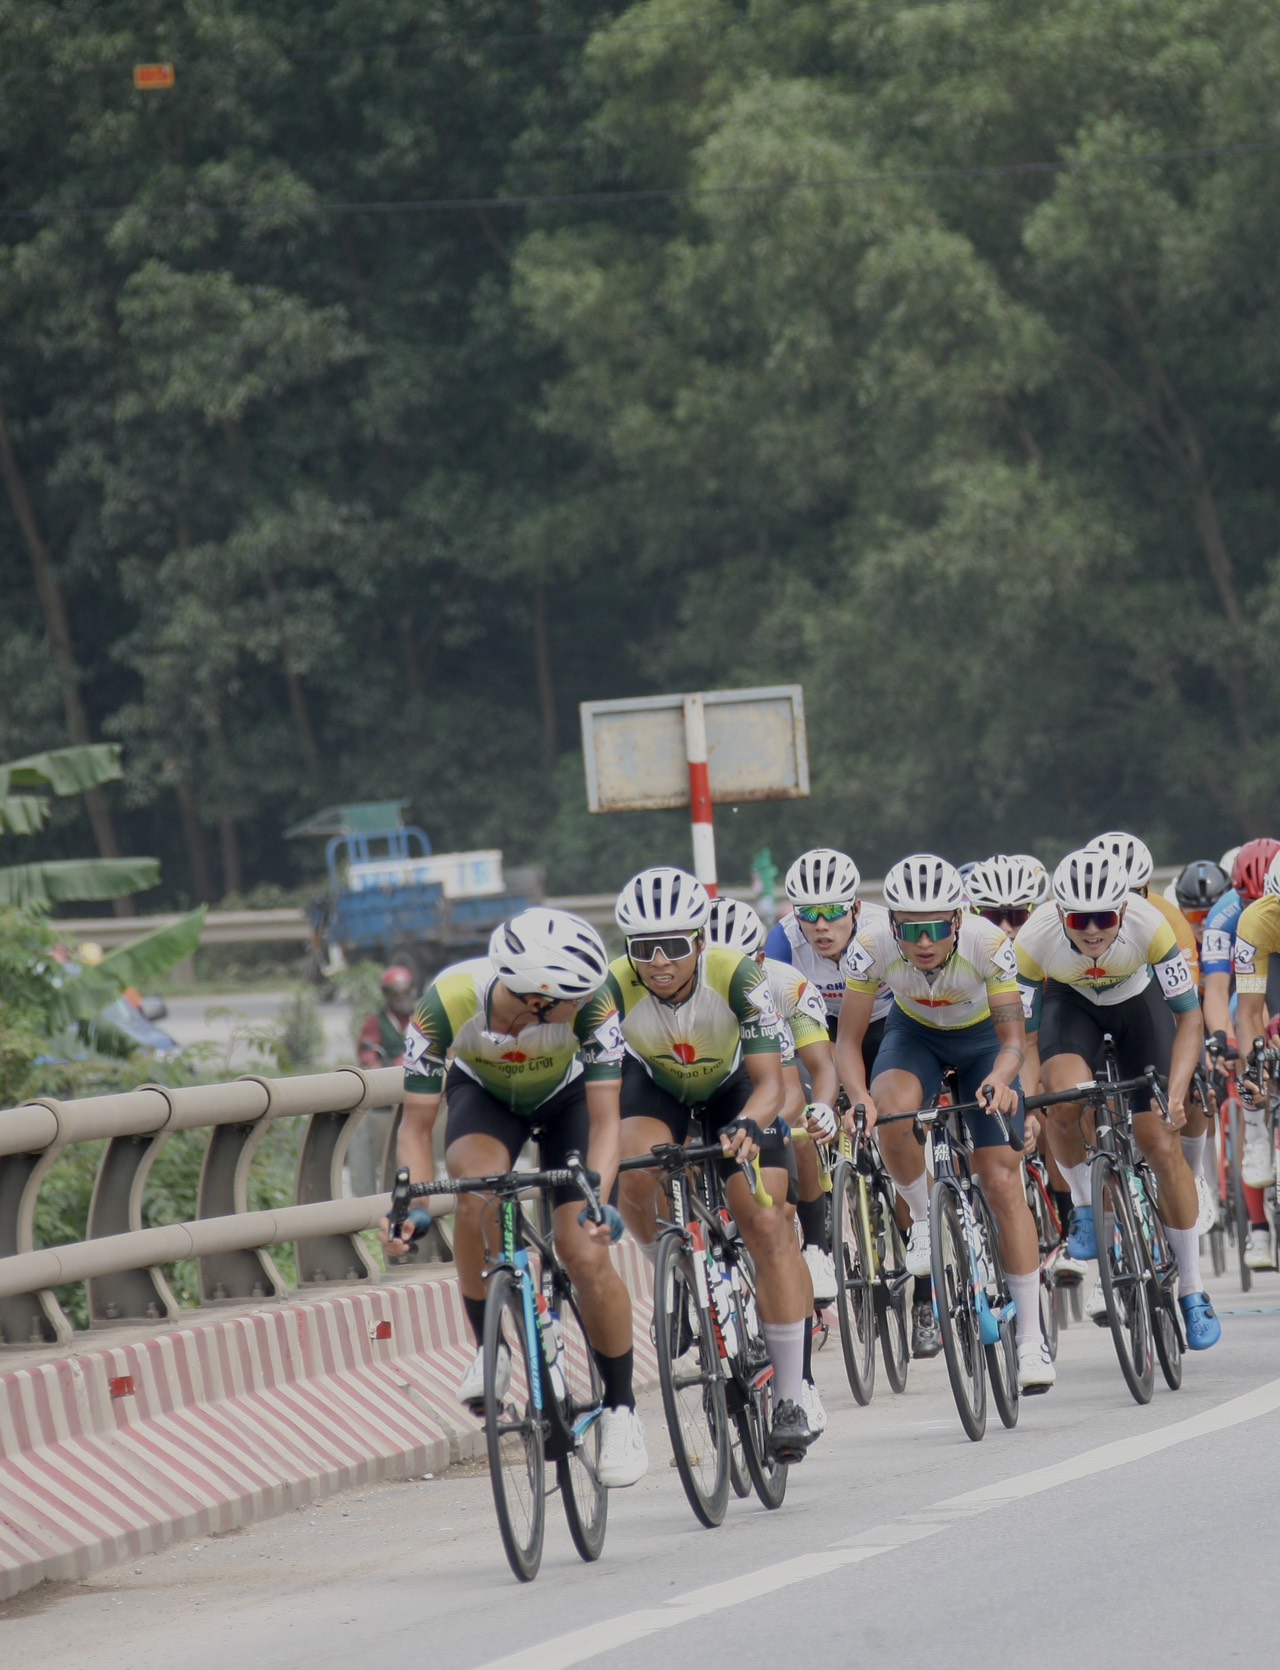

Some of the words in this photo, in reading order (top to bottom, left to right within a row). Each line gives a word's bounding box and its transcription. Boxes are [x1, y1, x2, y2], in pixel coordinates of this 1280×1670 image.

[1205, 935, 1223, 951] 14
[1165, 961, 1188, 987] 35
[671, 1179, 684, 1228] GIANT
